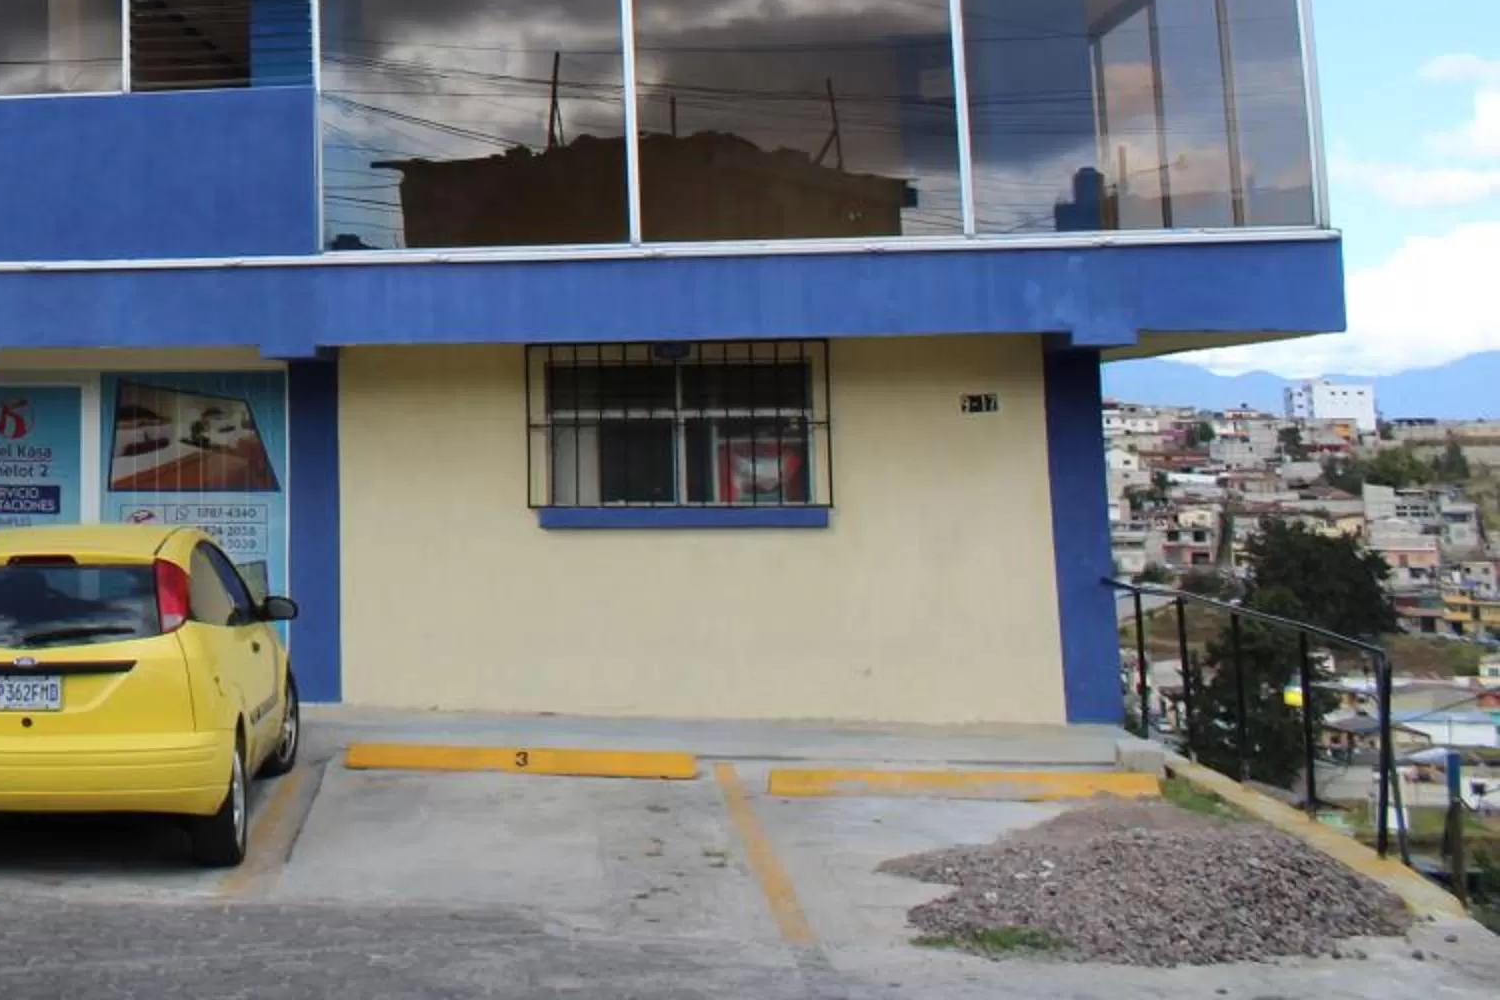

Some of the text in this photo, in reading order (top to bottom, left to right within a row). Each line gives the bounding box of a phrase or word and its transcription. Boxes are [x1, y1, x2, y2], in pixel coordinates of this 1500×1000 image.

[17, 444, 53, 458] Kasa
[39, 463, 50, 478] 2
[515, 751, 529, 767] 3
